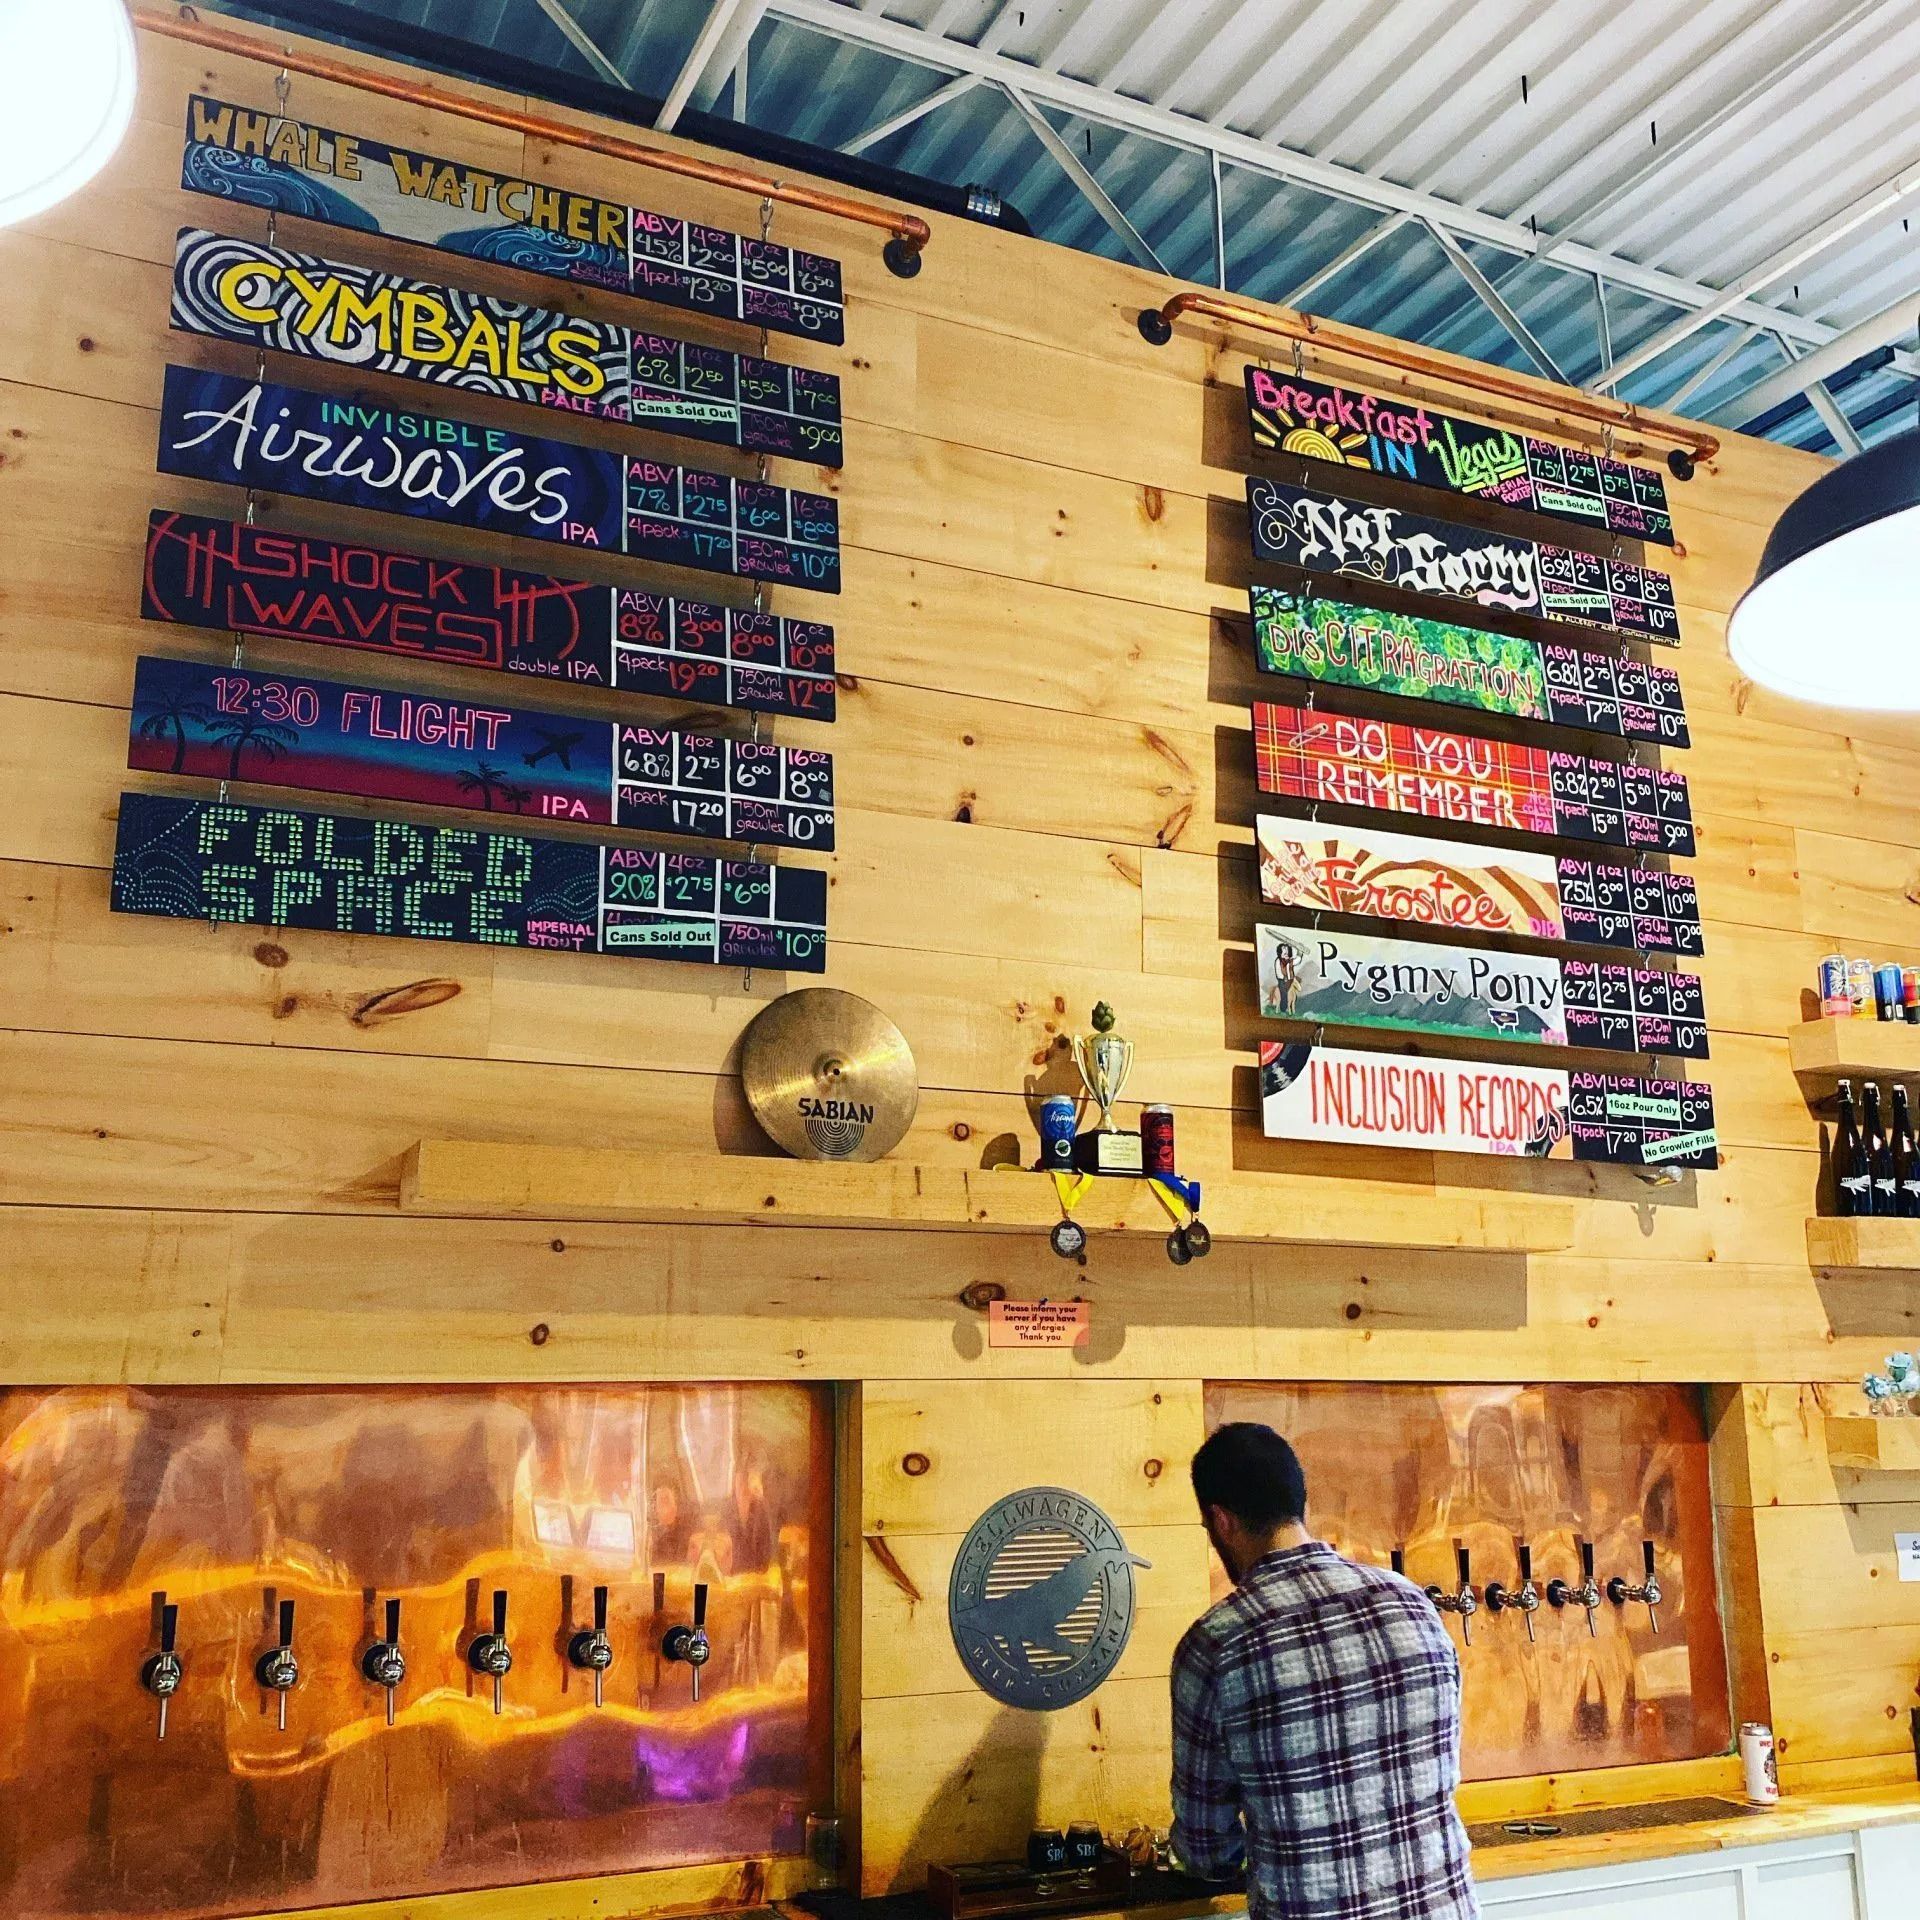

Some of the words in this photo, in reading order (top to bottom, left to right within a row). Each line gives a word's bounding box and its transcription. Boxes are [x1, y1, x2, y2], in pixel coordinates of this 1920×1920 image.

[194, 101, 361, 181] WHALE
[389, 151, 626, 249] WATCHER
[635, 212, 681, 236] ABV
[218, 261, 604, 395] CYMBALS
[633, 335, 678, 355] ABV
[637, 356, 676, 385] 6%
[541, 388, 598, 413] PALE
[602, 404, 628, 420] ALE
[637, 402, 672, 414] Cans
[675, 404, 704, 417] Sold
[708, 407, 734, 419] Out
[1252, 370, 1434, 448] Breakfast
[321, 402, 506, 452] INVISIBLE
[172, 384, 571, 524] Airwaves
[1369, 434, 1417, 479] IN
[1428, 418, 1522, 488] Vegas
[1529, 439, 1558, 456] ABV
[629, 463, 674, 484] ABV
[1530, 457, 1562, 480] 7.5%
[630, 486, 670, 511] 7%
[1480, 476, 1530, 498] IMPERIAL
[1501, 484, 1532, 504] PORTER
[1541, 495, 1563, 506] Cans
[1566, 498, 1584, 509] Sold
[1587, 505, 1603, 513] Out
[562, 521, 599, 545] IPA
[1540, 544, 1565, 557] ABV
[248, 536, 467, 604] SHOCK
[1397, 533, 1539, 611] Sorry
[620, 592, 663, 613] ABV
[1546, 595, 1567, 605] Cans
[1570, 596, 1588, 605] Sold
[1591, 597, 1606, 605] Out
[241, 582, 488, 658] WAVES
[620, 613, 664, 642] 8%
[1545, 645, 1573, 660] ABV
[508, 654, 560, 675] double
[567, 661, 603, 682] IPA
[734, 668, 782, 688] 750ml
[212, 677, 319, 726] 12:30
[341, 692, 511, 750] FLIGHT
[622, 727, 670, 746] ABV
[1335, 720, 1387, 762] DO
[1415, 731, 1492, 780] YOU
[1550, 751, 1581, 768] ABV
[624, 749, 671, 778] 6.8%
[542, 795, 589, 818] IPA
[1318, 760, 1522, 830] REMEMBER
[1530, 819, 1553, 833] IPA
[198, 807, 532, 888] FOLDED
[609, 849, 657, 869] ABV
[1558, 858, 1586, 875] ABV
[202, 864, 522, 944] SPACE
[1315, 858, 1513, 930] Frostee
[527, 920, 595, 937] IMPERIAL
[610, 932, 646, 943] Cans
[650, 930, 682, 942] Sold
[686, 930, 711, 942] Out
[528, 933, 584, 951] STOUT
[1317, 941, 1455, 1003] Pygmy
[1469, 957, 1559, 1010] Pony
[1564, 961, 1593, 975] ABV
[1572, 1072, 1605, 1089] ABV
[798, 1098, 874, 1124] SABIAN
[1311, 1060, 1445, 1135] INCLUSION
[1458, 1073, 1566, 1143] RECORDS
[1609, 1099, 1630, 1110] 16oz
[1633, 1102, 1653, 1112] Pour
[1656, 1104, 1677, 1115] Only
[1489, 1140, 1518, 1155] IPA
[1645, 1147, 1657, 1157] No
[1660, 1139, 1693, 1154] Growler
[1696, 1135, 1715, 1146] Fills
[1003, 1304, 1030, 1312] Please
[1031, 1304, 1057, 1313] inform
[1040, 1315, 1055, 1323] you
[1057, 1314, 1077, 1322] have
[1015, 1324, 1029, 1332] any
[1032, 1323, 1066, 1332] allergies
[1019, 1333, 1043, 1341] Thank
[961, 1496, 1107, 1597] STELLWAGEN
[973, 1645, 1016, 1689] BEER
[1043, 1609, 1126, 1698] COMPANY
